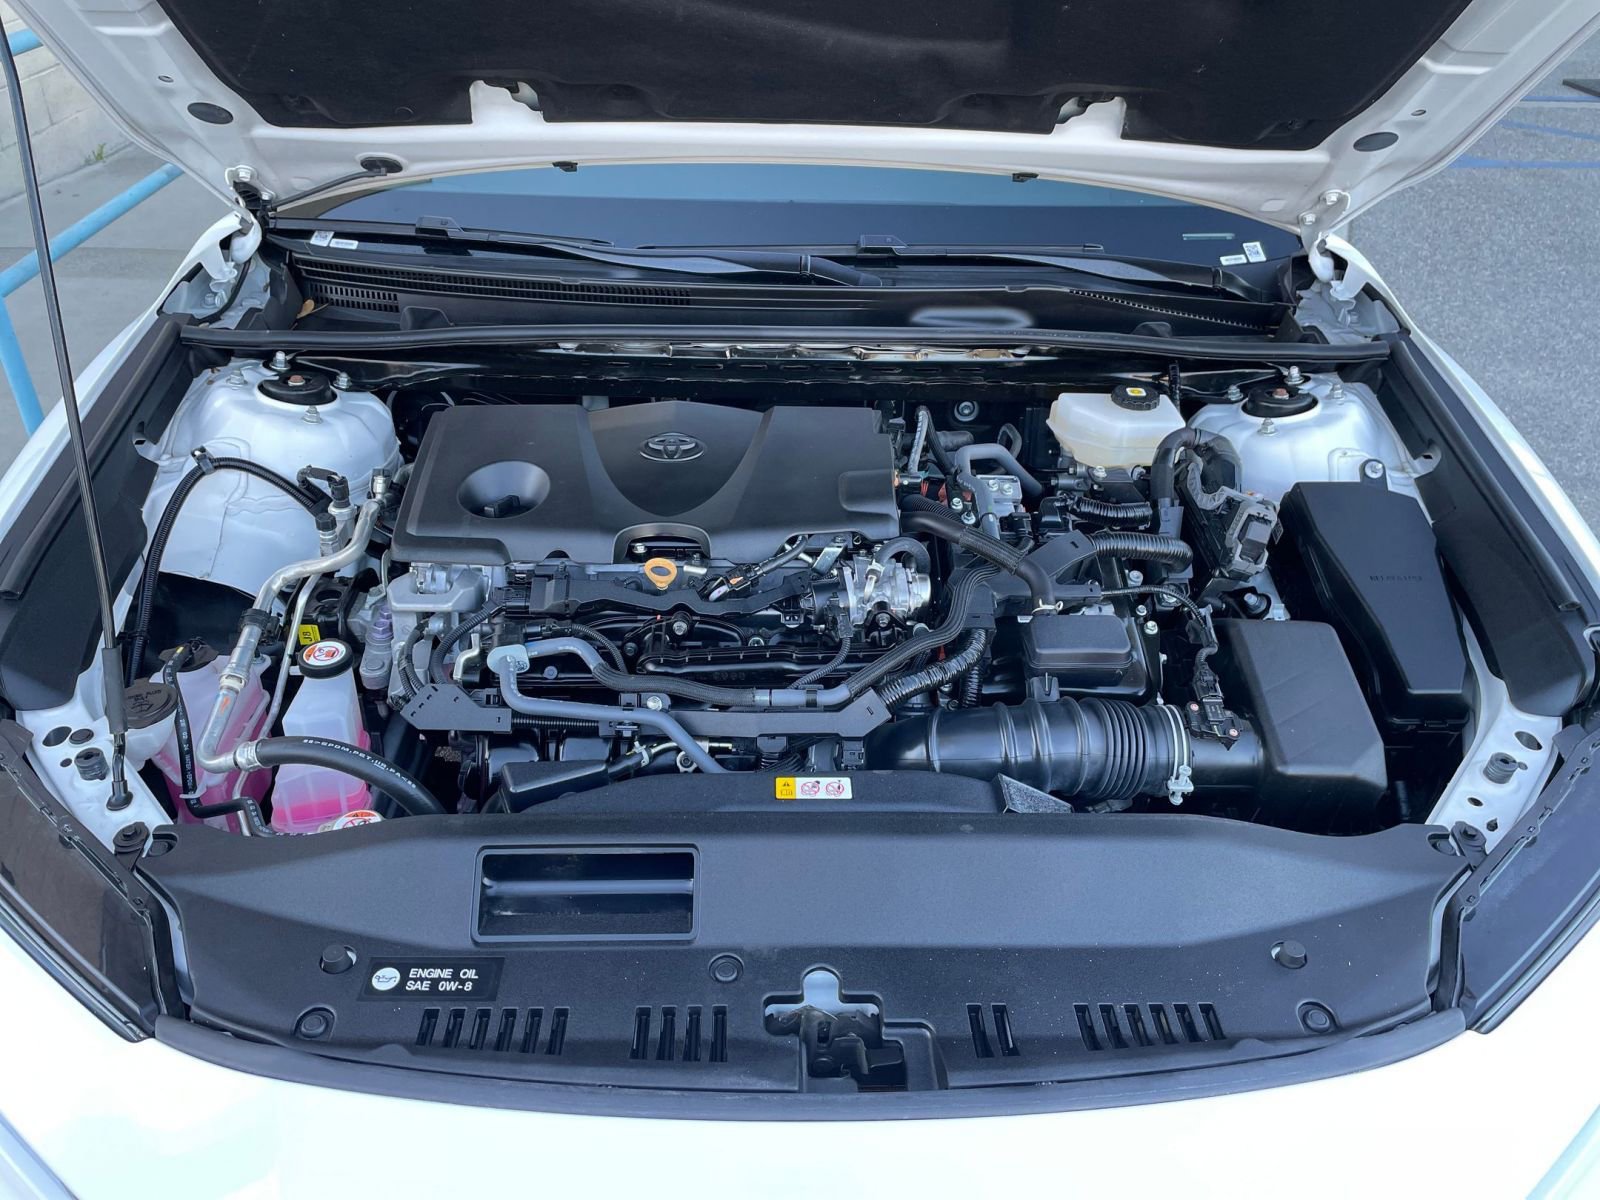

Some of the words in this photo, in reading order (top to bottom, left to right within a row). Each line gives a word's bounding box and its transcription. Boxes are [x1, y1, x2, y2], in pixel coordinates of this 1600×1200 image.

[409, 968, 453, 979] ENGINE
[459, 968, 479, 979] OIL
[405, 981, 431, 991] SAE
[438, 981, 473, 992] 0W-8
